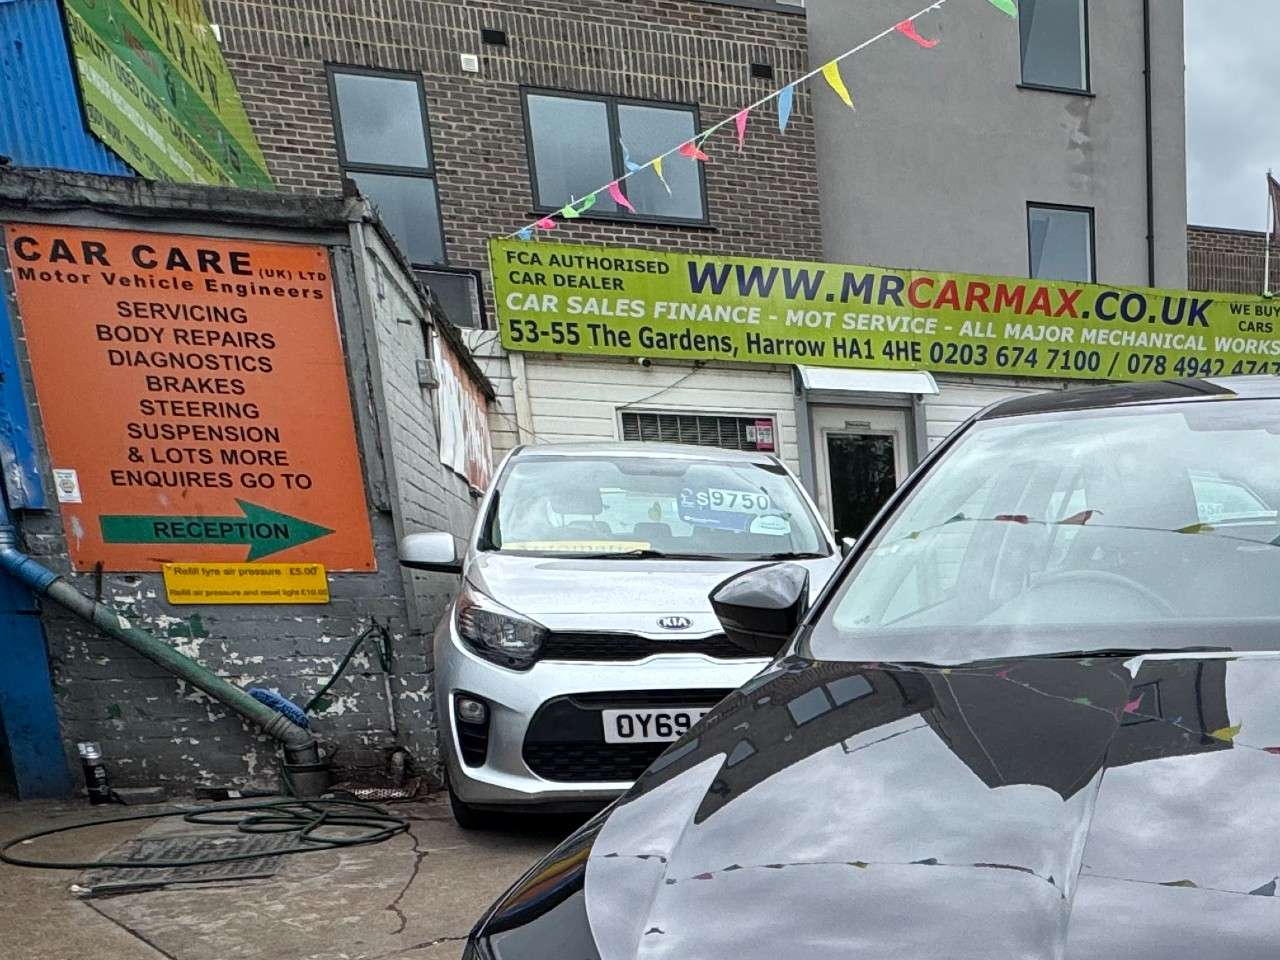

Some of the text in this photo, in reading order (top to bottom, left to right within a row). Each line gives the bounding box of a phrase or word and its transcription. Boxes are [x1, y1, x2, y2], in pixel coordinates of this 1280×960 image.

[13, 236, 327, 281] CAR CARE (UK) LTD
[506, 251, 670, 274] FCA AUTHORISED
[16, 267, 325, 300] Motor Vehicle Engineers
[509, 271, 624, 291] CAR DEALER
[687, 261, 1214, 328] WWW.MRCARMAX.CO.UK
[116, 301, 248, 324] SERVICING
[1229, 303, 1251, 316] WE
[506, 292, 559, 313] CAR
[566, 297, 646, 318] SALES
[653, 302, 761, 324] FINANCE
[785, 309, 837, 328] MOT
[842, 313, 936, 335] SERVICE
[959, 320, 997, 338] ALL
[1004, 324, 1074, 343] MAJOR
[1080, 328, 1207, 350] MECHANICAL
[1238, 320, 1273, 334] CARS
[96, 324, 276, 350] BODY REPAIRS
[509, 320, 581, 346] 53-55
[588, 323, 632, 348] The
[638, 328, 739, 356] Gardens,
[746, 333, 824, 358] Harrow
[833, 337, 874, 360] HA1
[882, 340, 922, 362] 4HE
[930, 343, 988, 366] 0203
[995, 346, 1038, 368] 674
[1047, 350, 1100, 372] 7100
[1107, 352, 1120, 377] /
[1128, 353, 1167, 376] 078
[1174, 357, 1224, 377] 4942
[107, 350, 274, 374] DIAGNOSTICS
[146, 376, 245, 395] BRAKES
[140, 399, 260, 419] STEERING
[127, 423, 281, 443] SUSPENSION
[128, 447, 289, 466] & LOTS MORE
[110, 470, 312, 490] ENQUIRES GO TO
[711, 492, 768, 510] 9750
[153, 522, 289, 539] RECEPTION
[239, 568, 281, 578] pressure
[662, 618, 688, 626] KIA
[616, 713, 691, 738] OY69
